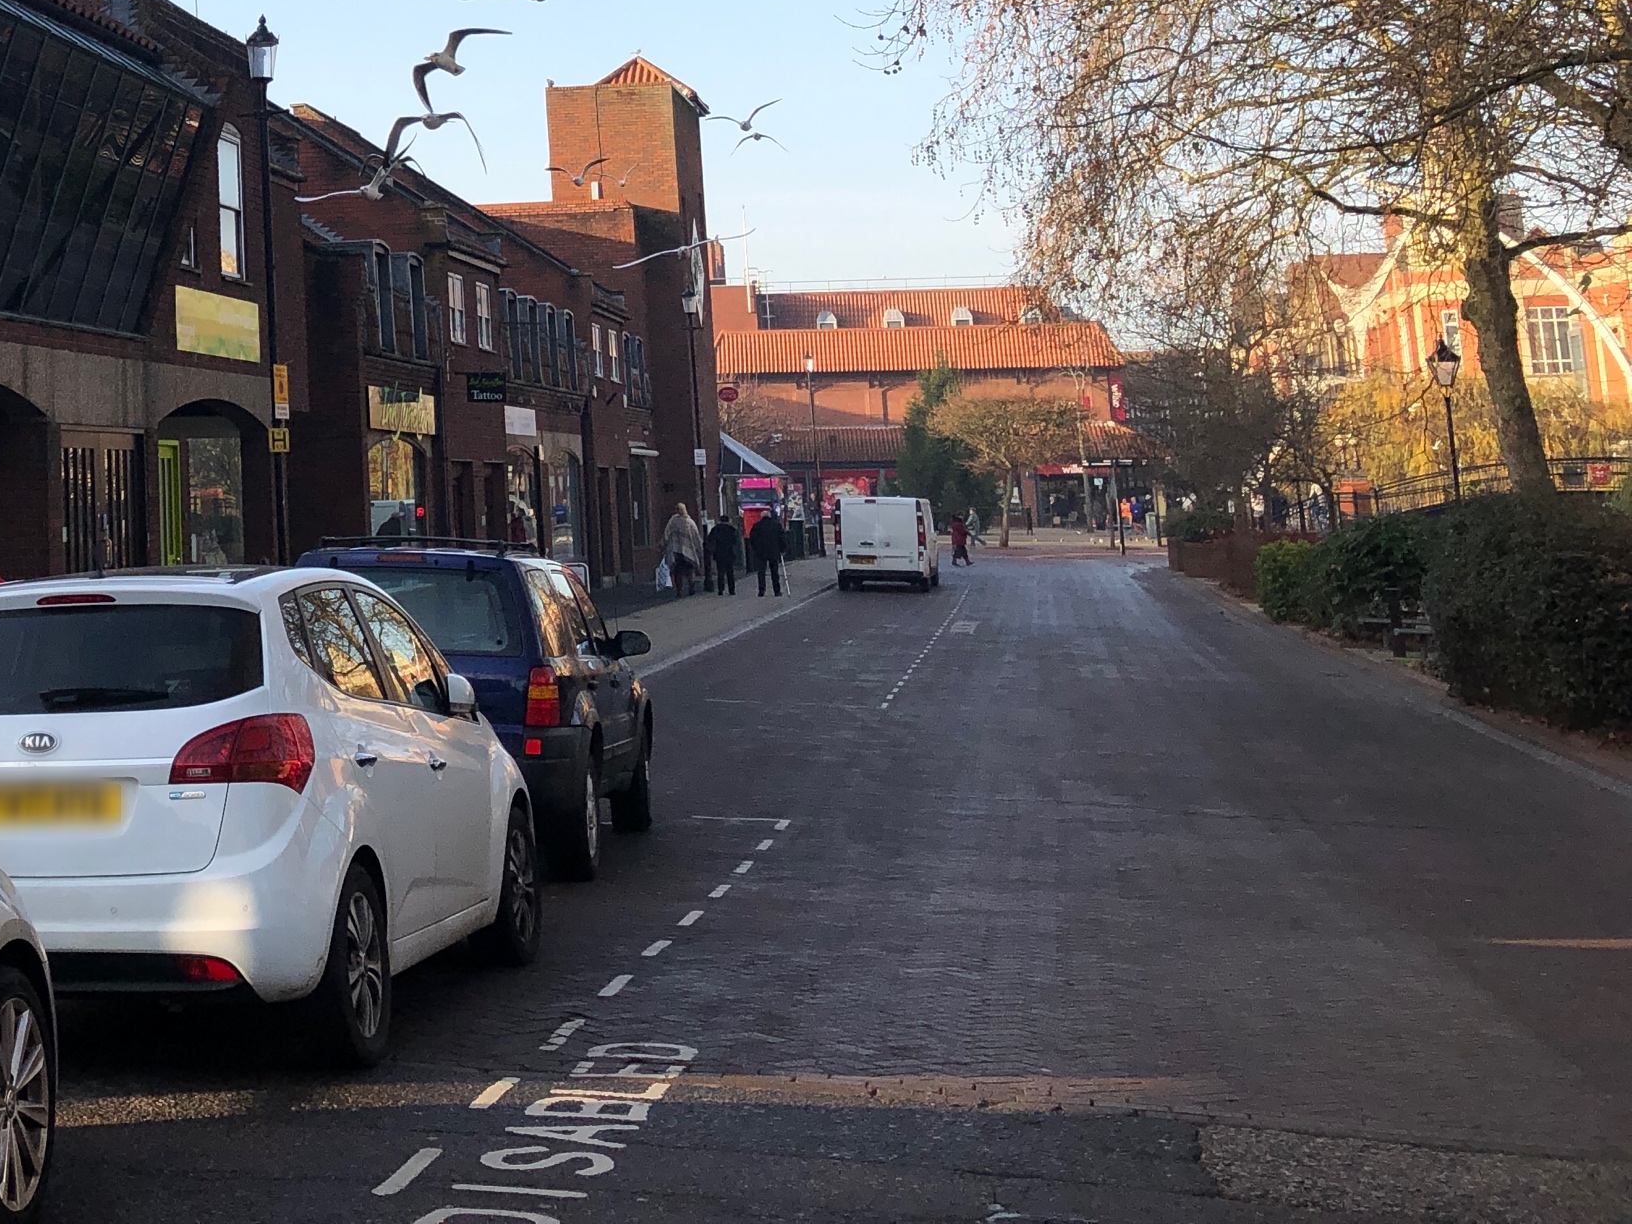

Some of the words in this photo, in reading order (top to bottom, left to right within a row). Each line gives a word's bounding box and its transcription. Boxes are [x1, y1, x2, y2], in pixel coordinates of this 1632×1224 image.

[471, 390, 503, 400] Tattoo
[271, 431, 287, 450] H
[24, 735, 51, 748] KIA
